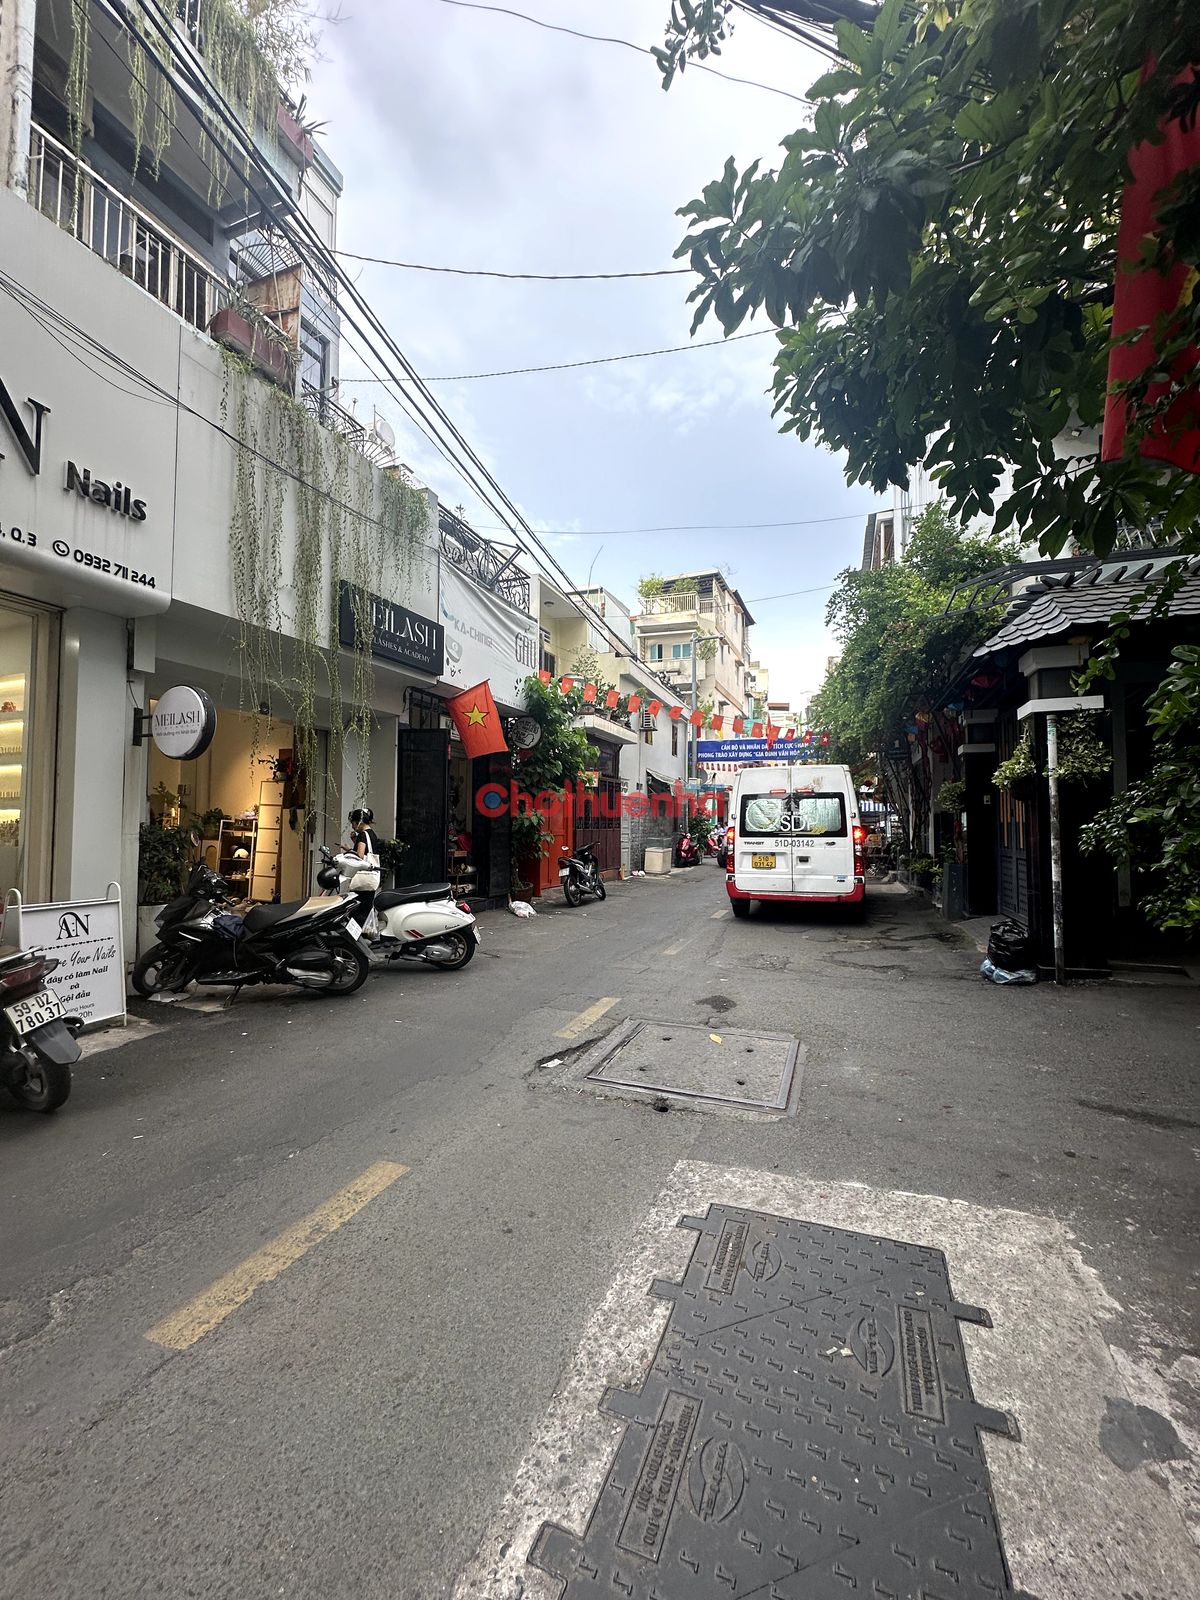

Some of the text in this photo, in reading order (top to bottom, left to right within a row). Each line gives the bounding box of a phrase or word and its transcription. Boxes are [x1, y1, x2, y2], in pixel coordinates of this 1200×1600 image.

[65, 460, 147, 521] Nails
[74, 549, 111, 575] 0932
[114, 563, 129, 580] 711
[131, 570, 156, 589] 244
[355, 594, 436, 650] EILASH
[155, 710, 200, 727] MEILASH
[774, 839, 815, 848] 51D-03142
[70, 950, 91, 967] Your
[93, 945, 117, 962] Nails
[46, 974, 63, 985] đây
[64, 971, 74, 980] có
[75, 969, 91, 979] làm
[12, 993, 53, 1018] 59-D2
[15, 1002, 62, 1034] 780.37
